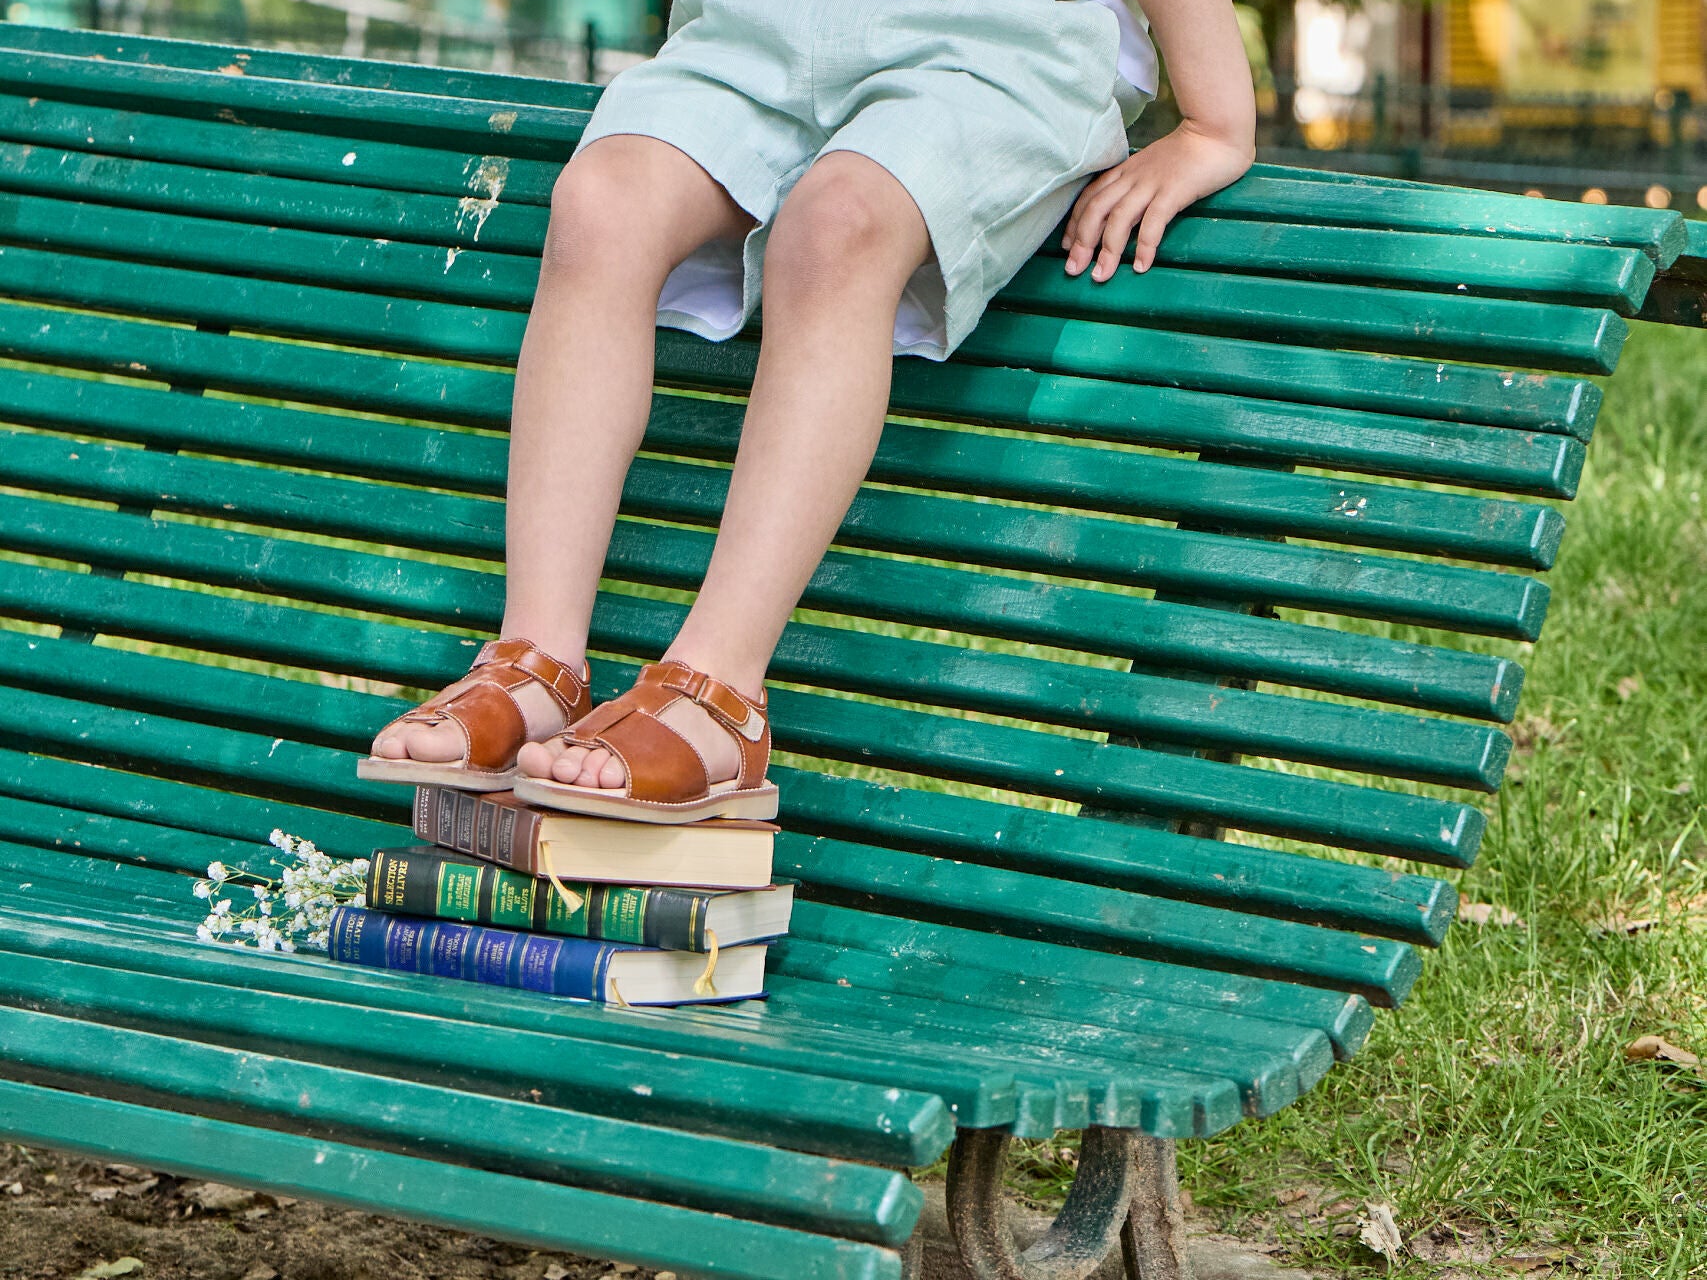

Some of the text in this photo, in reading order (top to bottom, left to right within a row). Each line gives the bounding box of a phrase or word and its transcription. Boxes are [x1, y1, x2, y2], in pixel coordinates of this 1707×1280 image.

[385, 858, 398, 905] SÉLECTION
[395, 860, 408, 906] DU LIVRE
[354, 915, 366, 944] LIVRE
